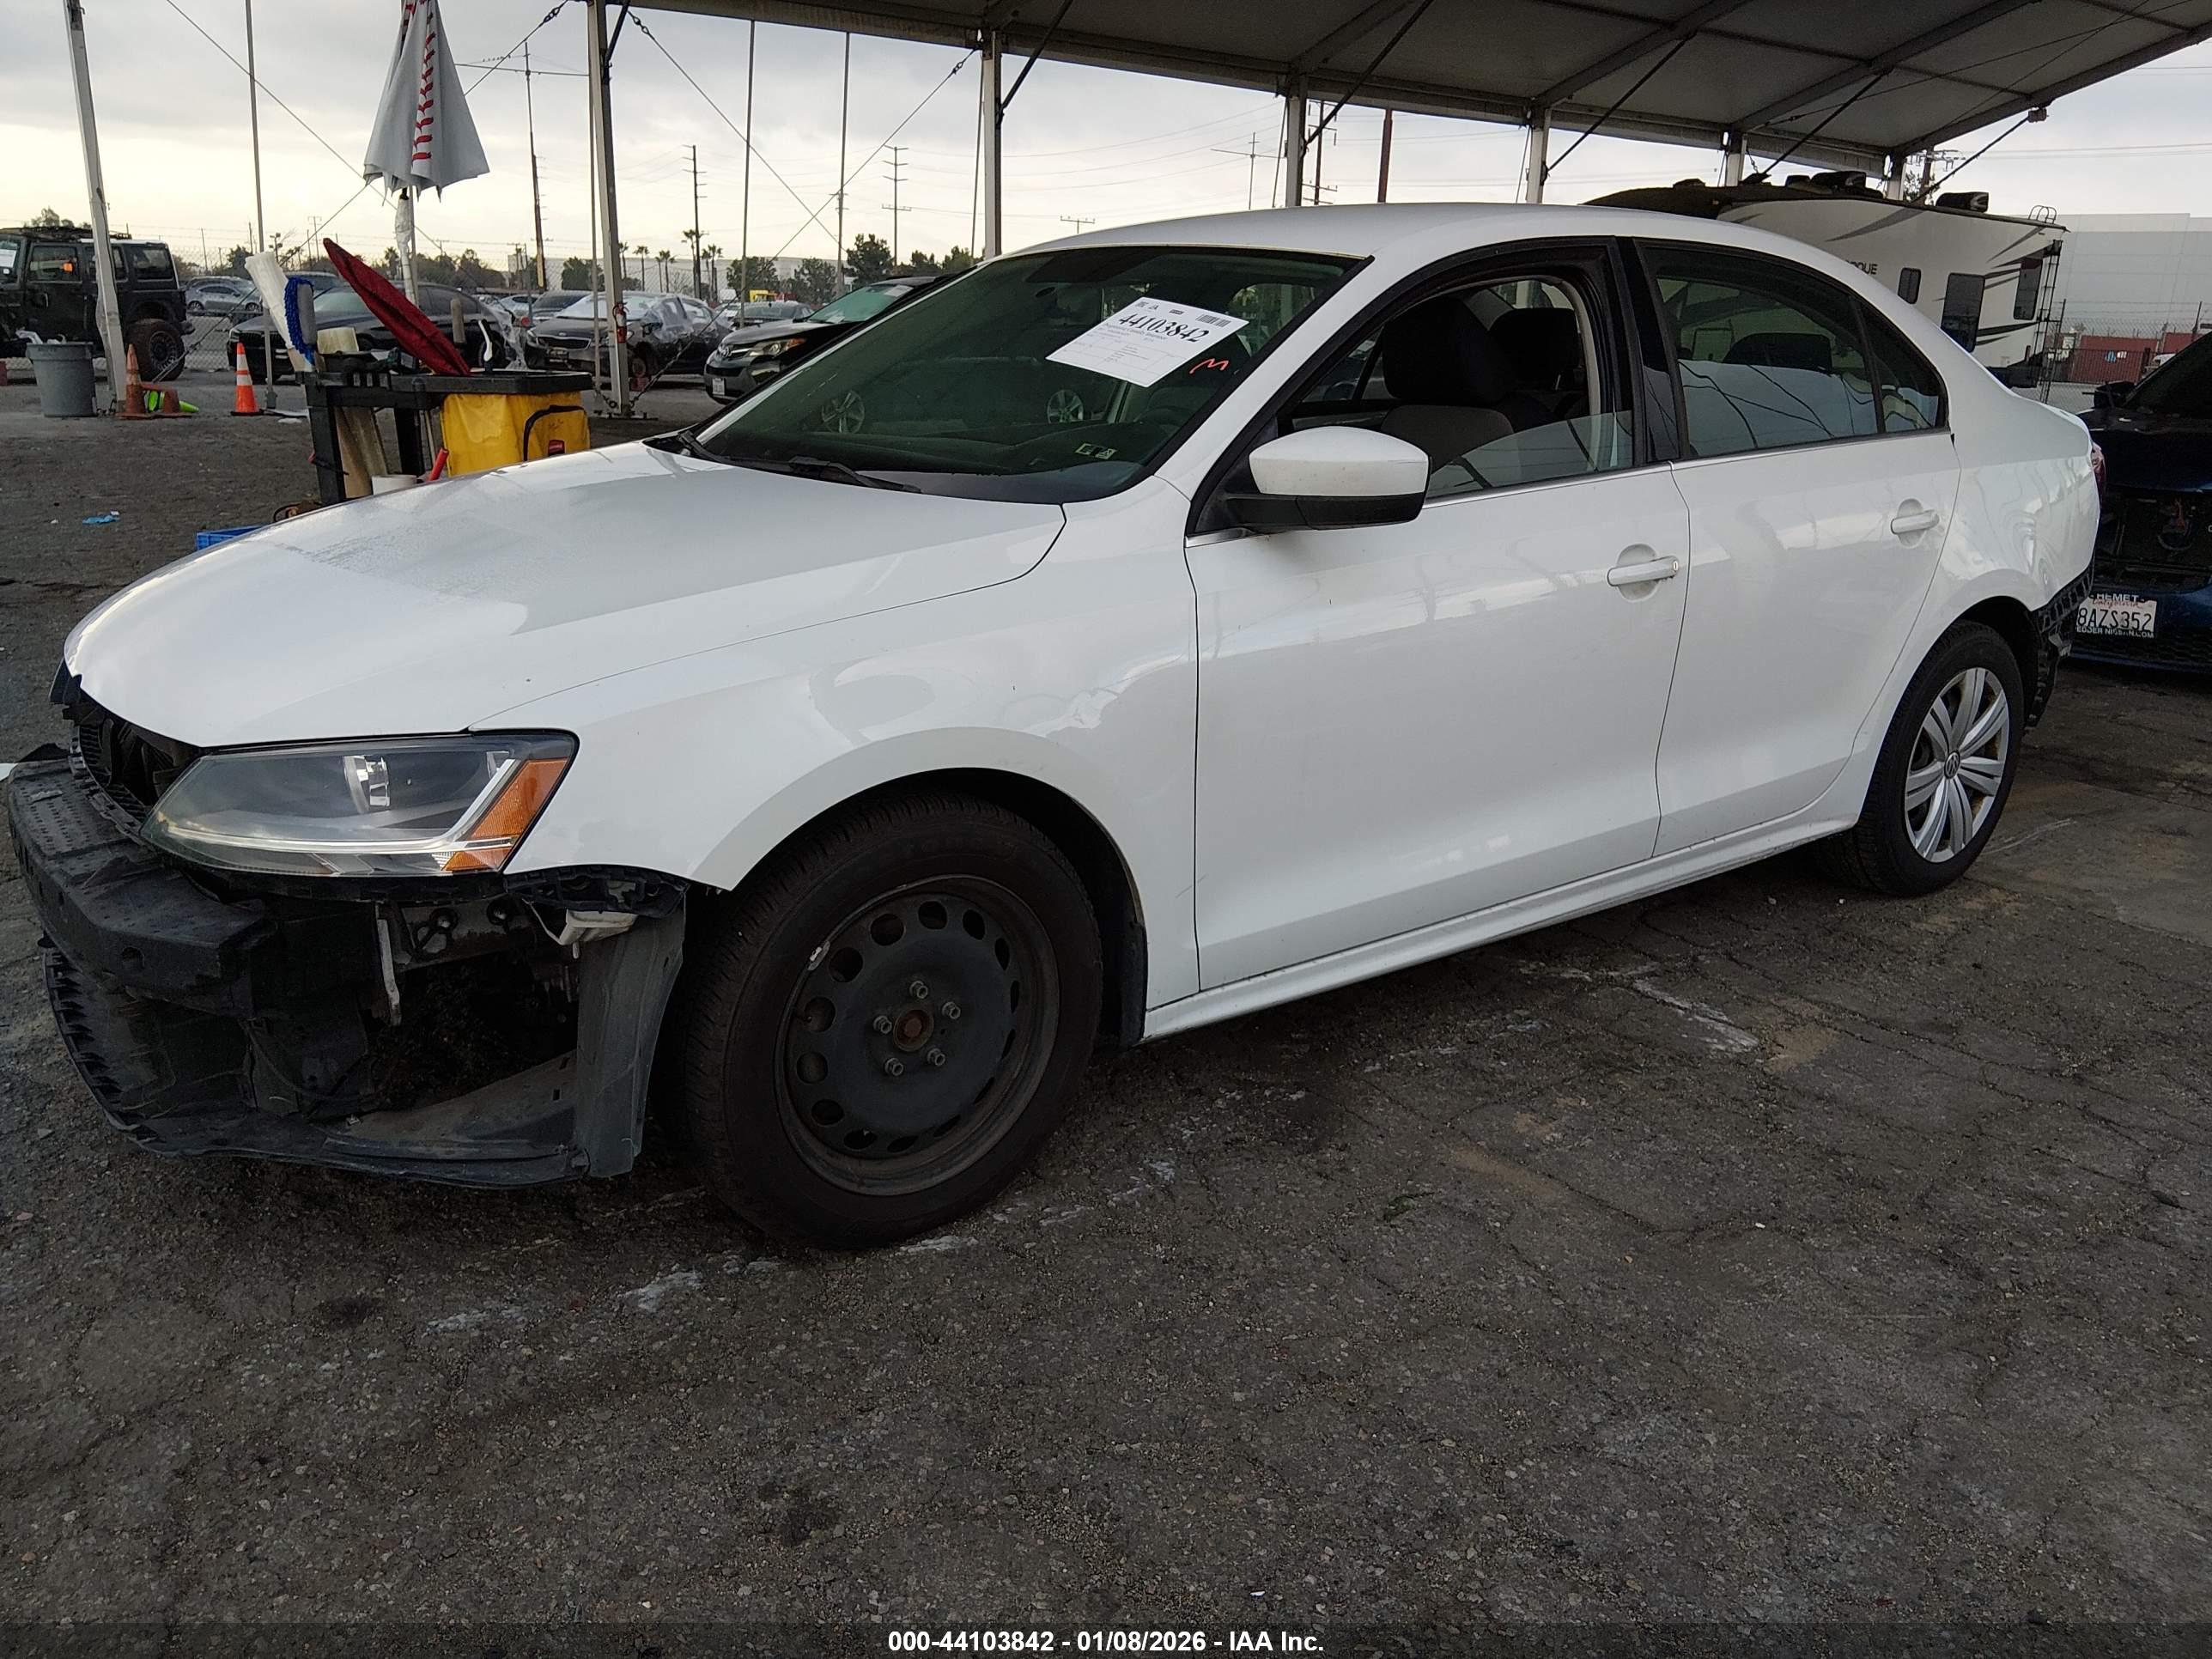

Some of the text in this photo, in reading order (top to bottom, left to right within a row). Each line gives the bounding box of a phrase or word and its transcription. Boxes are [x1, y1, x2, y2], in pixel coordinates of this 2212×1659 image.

[1119, 313, 1210, 343] 44103842
[2096, 592, 2140, 604] HEMET
[2076, 607, 2152, 632] 8AZS352
